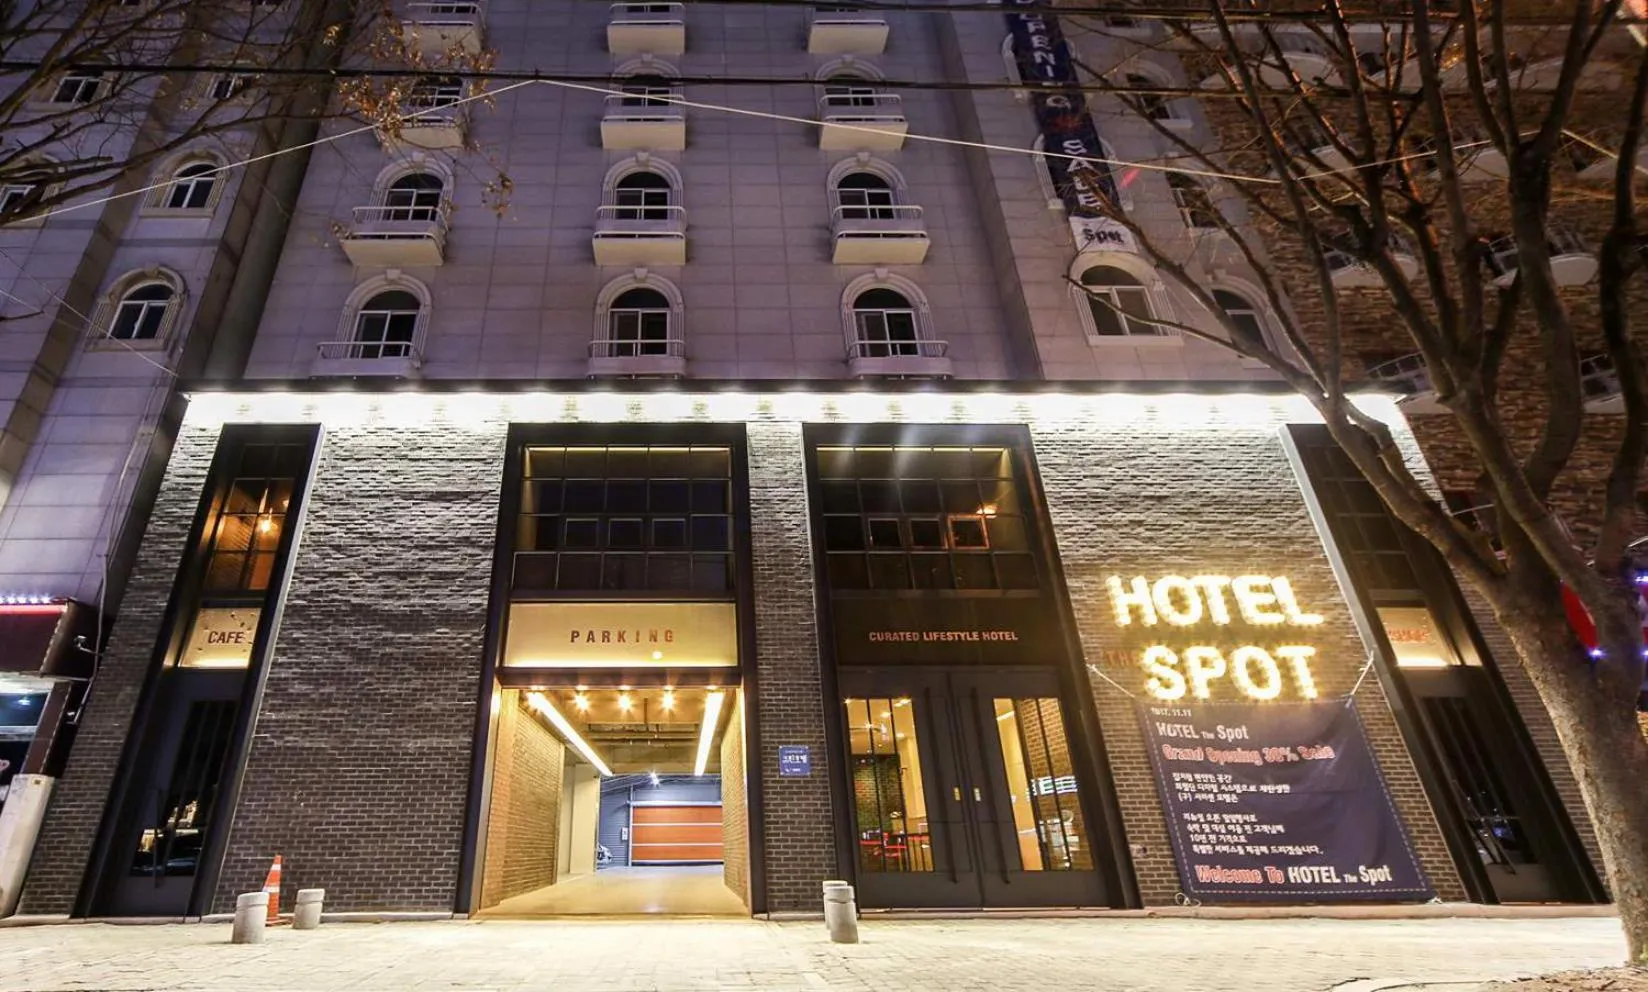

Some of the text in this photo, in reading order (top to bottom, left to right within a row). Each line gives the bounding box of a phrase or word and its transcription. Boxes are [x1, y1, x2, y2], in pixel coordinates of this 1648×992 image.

[1020, 7, 1071, 108] OPENIG
[1106, 575, 1324, 627] HOTEL
[208, 631, 245, 643] CAFE
[570, 630, 673, 643] PARKING
[869, 631, 1018, 642] CURATED LIFESTYLE HOTEL
[1143, 645, 1318, 700] SPOT
[1156, 722, 1200, 739] HOTEL
[1216, 724, 1249, 742] Spot
[1162, 744, 1204, 761] Grand
[1205, 746, 1263, 767] Opening
[1194, 865, 1392, 886] Welcome To HOTEL The Spot
